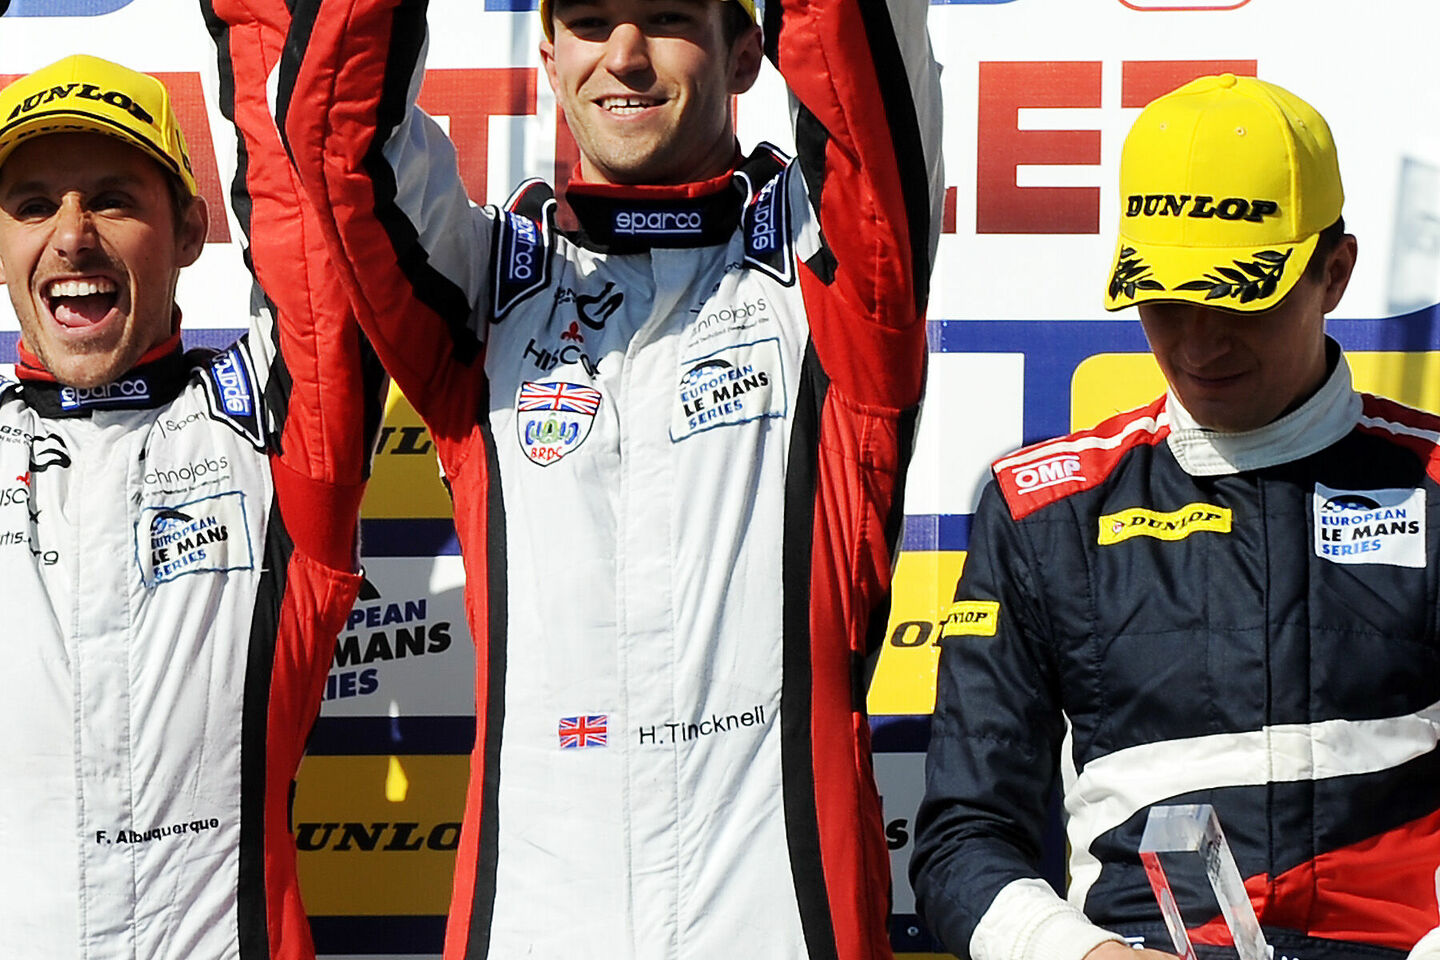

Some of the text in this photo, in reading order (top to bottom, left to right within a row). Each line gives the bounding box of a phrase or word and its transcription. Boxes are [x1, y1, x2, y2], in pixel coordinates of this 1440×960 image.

[7, 83, 154, 125] DUNLOP
[615, 211, 702, 234] sparco
[1126, 194, 1278, 224] DUNLOP
[680, 364, 753, 403] EUROPEAN
[683, 371, 769, 418] LE MANS
[688, 398, 743, 431] SERIES
[144, 456, 228, 485] chnojobs
[1014, 459, 1081, 488] OMP
[1130, 511, 1222, 531] DUNLOP
[1321, 508, 1407, 526] EUROPEAN
[1321, 521, 1420, 541] LE MANS
[151, 516, 217, 549] EUROPEAN
[152, 525, 228, 566] LE MANS
[1322, 539, 1382, 556] SERIES
[153, 548, 207, 579] SERIES
[346, 599, 427, 632] PEAN
[325, 668, 379, 701] IES
[640, 705, 766, 744] H.Tincknell
[96, 818, 220, 844] F. Albuquerque
[295, 822, 461, 852] UNLO
